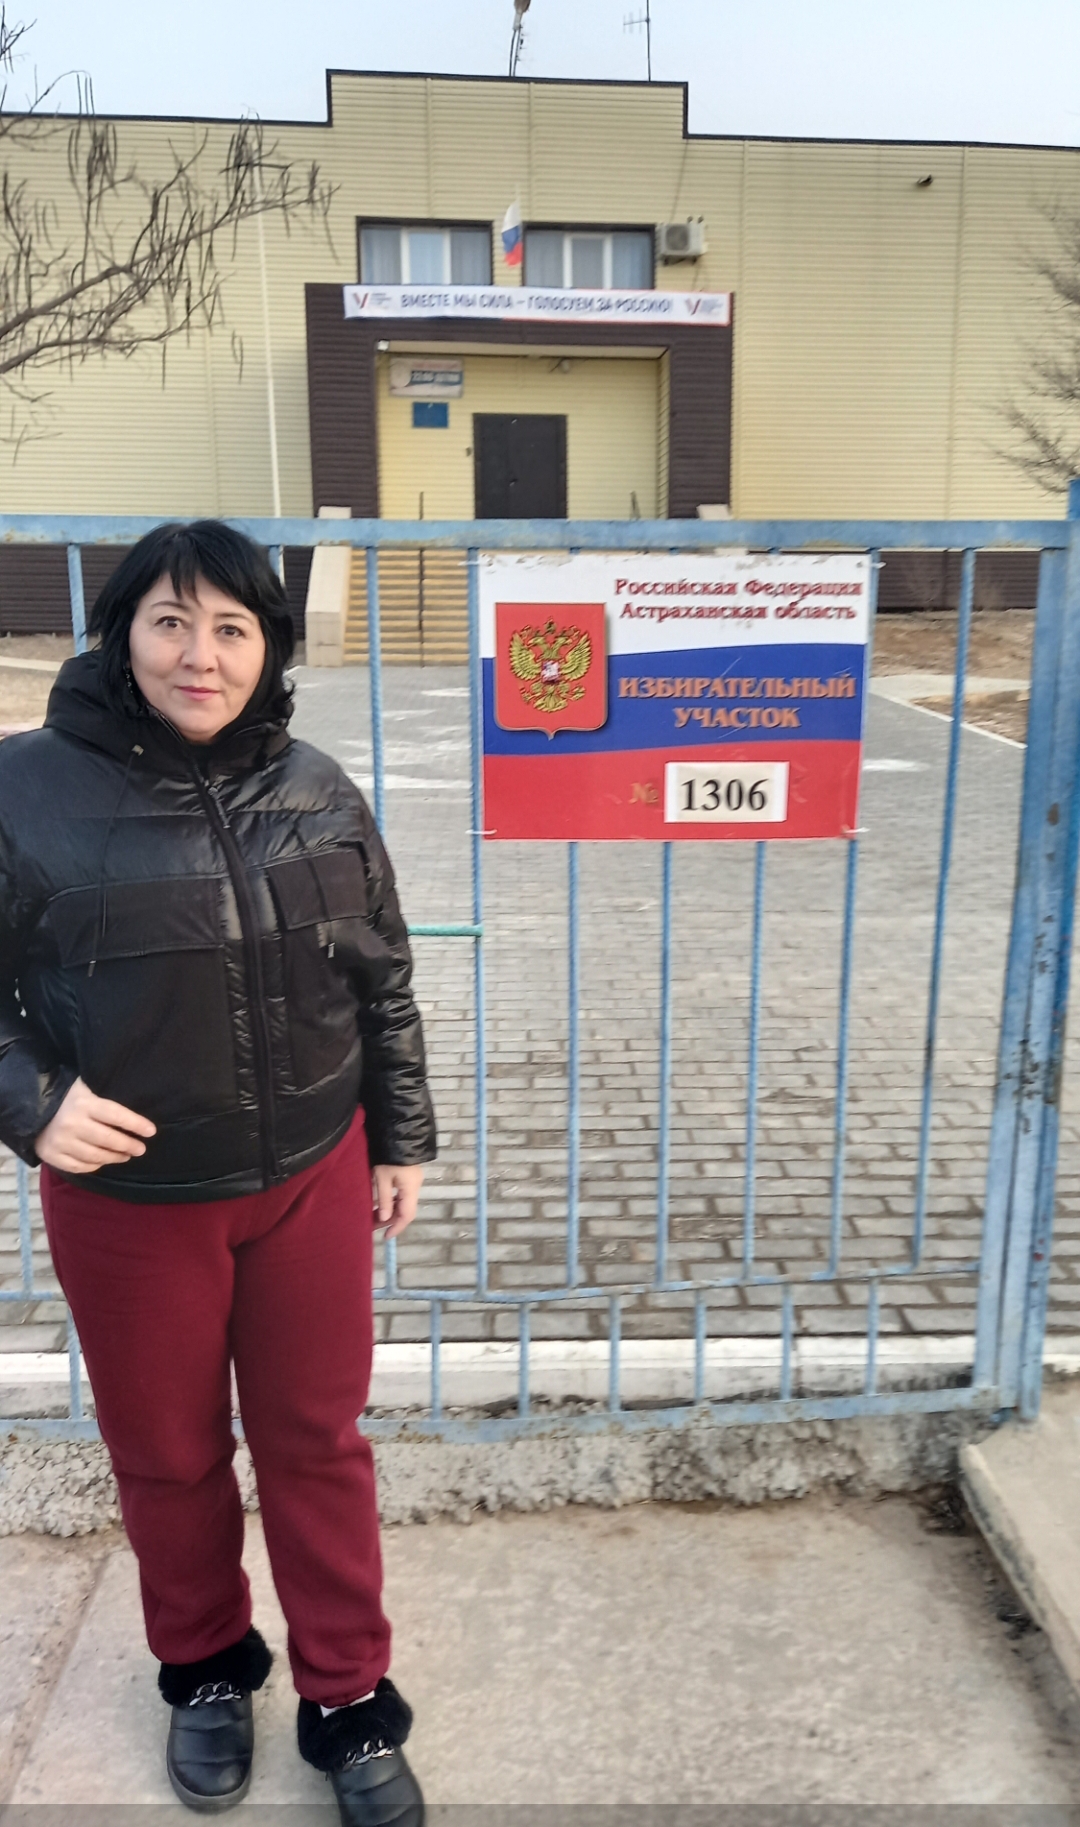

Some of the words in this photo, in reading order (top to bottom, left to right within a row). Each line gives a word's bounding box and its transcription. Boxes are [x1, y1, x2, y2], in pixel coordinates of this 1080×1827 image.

[401, 293, 450, 308] ВМЕСТЕ
[453, 294, 477, 309] МЫ
[480, 294, 513, 310] СИЛА
[527, 295, 593, 312] ГОЛОСУЕМ
[614, 578, 738, 596] Российская
[743, 579, 863, 600] Федерация
[619, 602, 768, 624] Астраханская
[774, 600, 857, 620] область
[618, 673, 857, 699] ИЗБИРАТЕЛЬНЫЙ
[673, 707, 801, 729] УЧАСТОК
[629, 782, 660, 804] №
[680, 778, 770, 811] 1306
